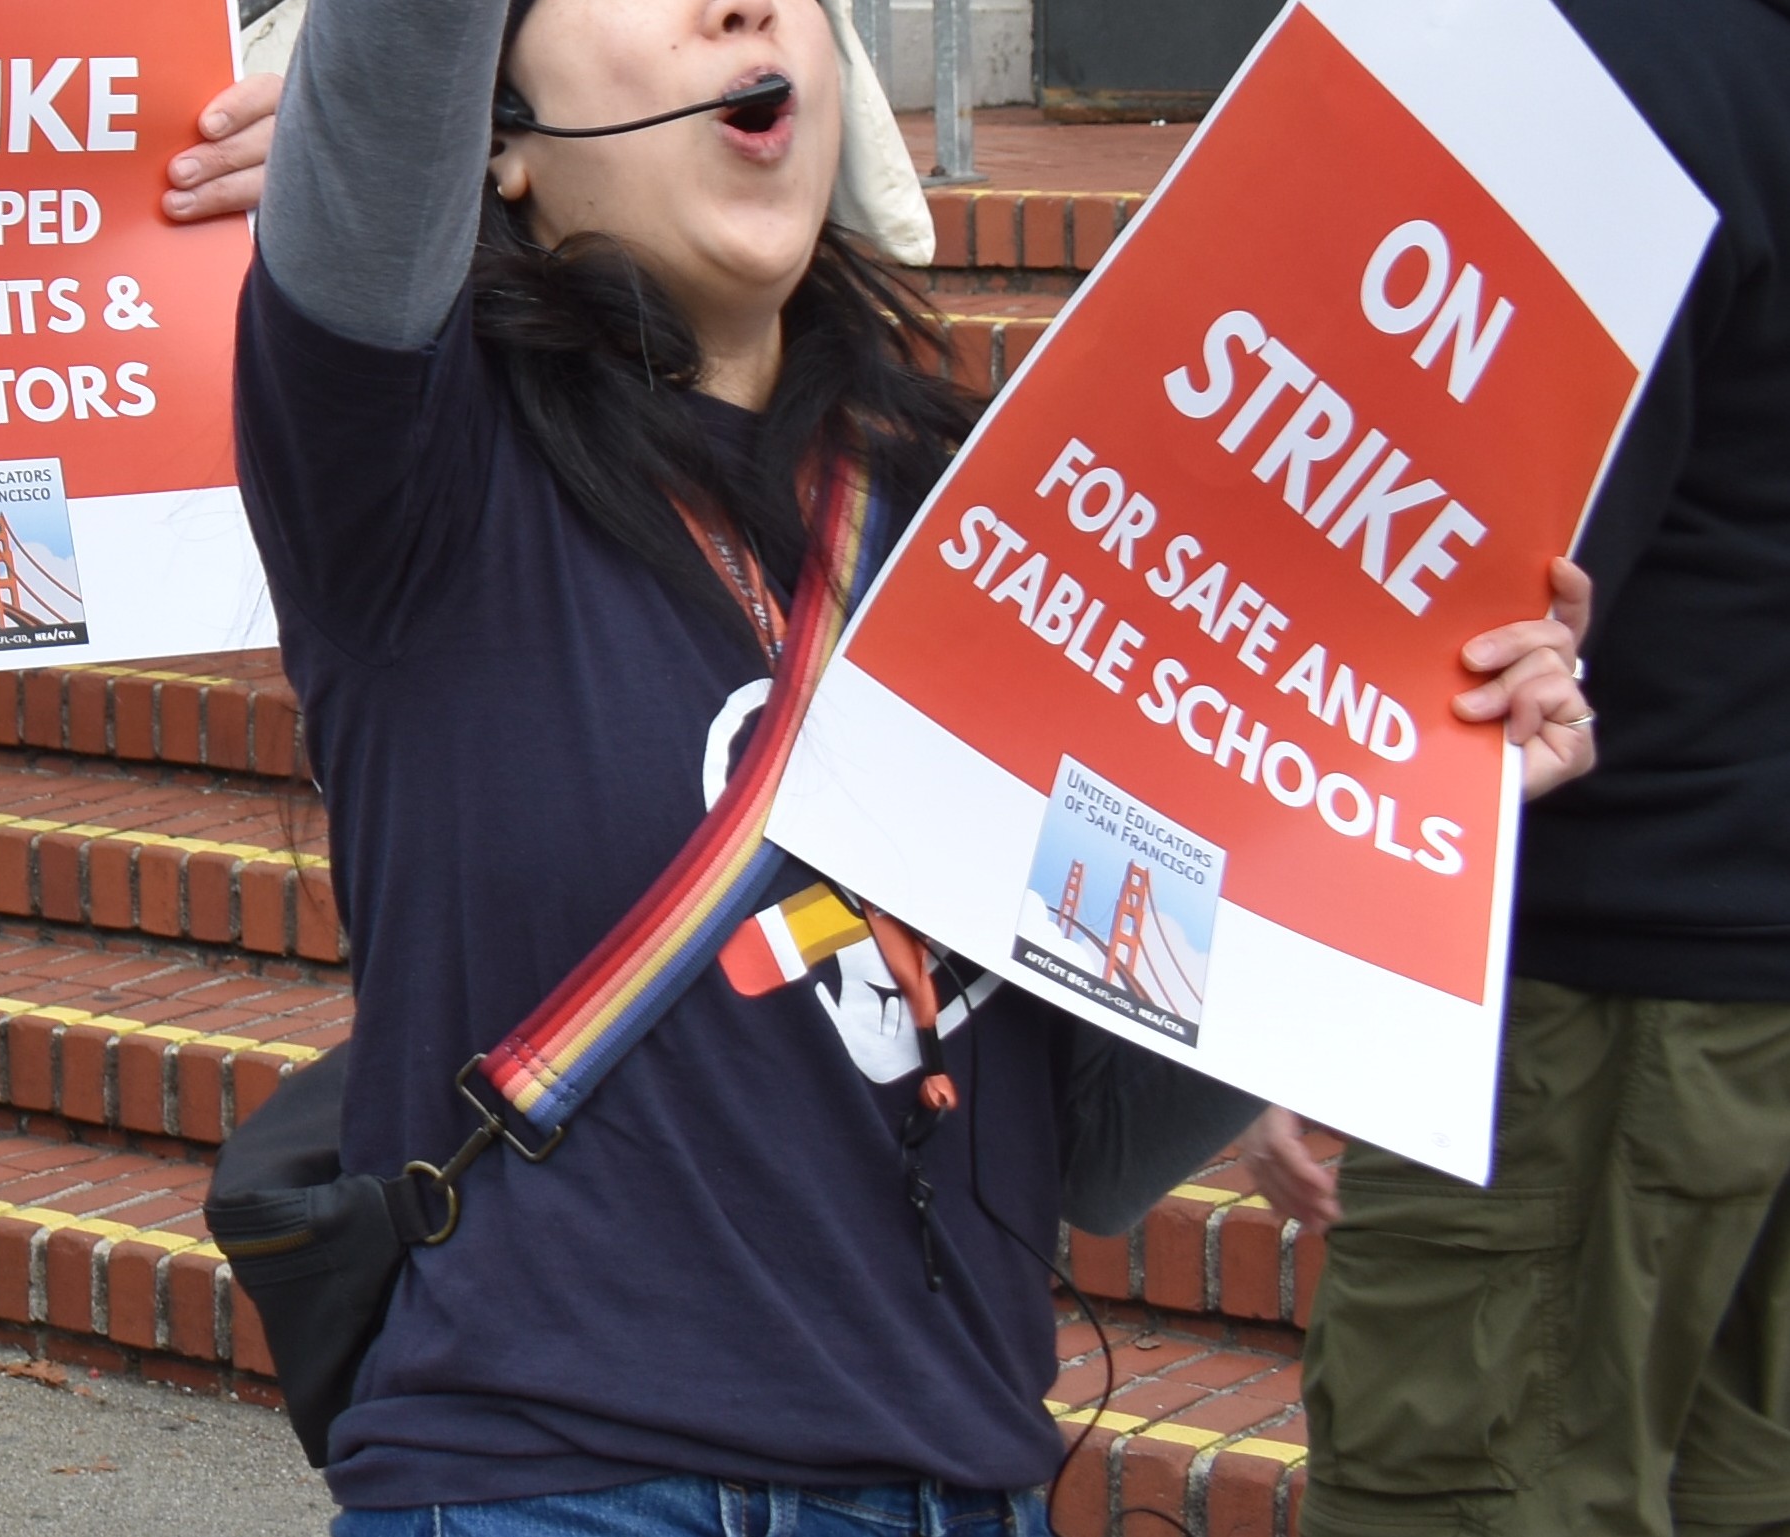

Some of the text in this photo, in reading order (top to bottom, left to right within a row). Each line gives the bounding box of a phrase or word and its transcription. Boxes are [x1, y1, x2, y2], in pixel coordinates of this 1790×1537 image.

[103, 275, 161, 331] &
[1359, 219, 1515, 404] ON
[1033, 436, 1418, 763] FOR SAFE AND
[1163, 309, 1488, 617] STRIKE
[938, 504, 1465, 876] STABLE SCHOOLS
